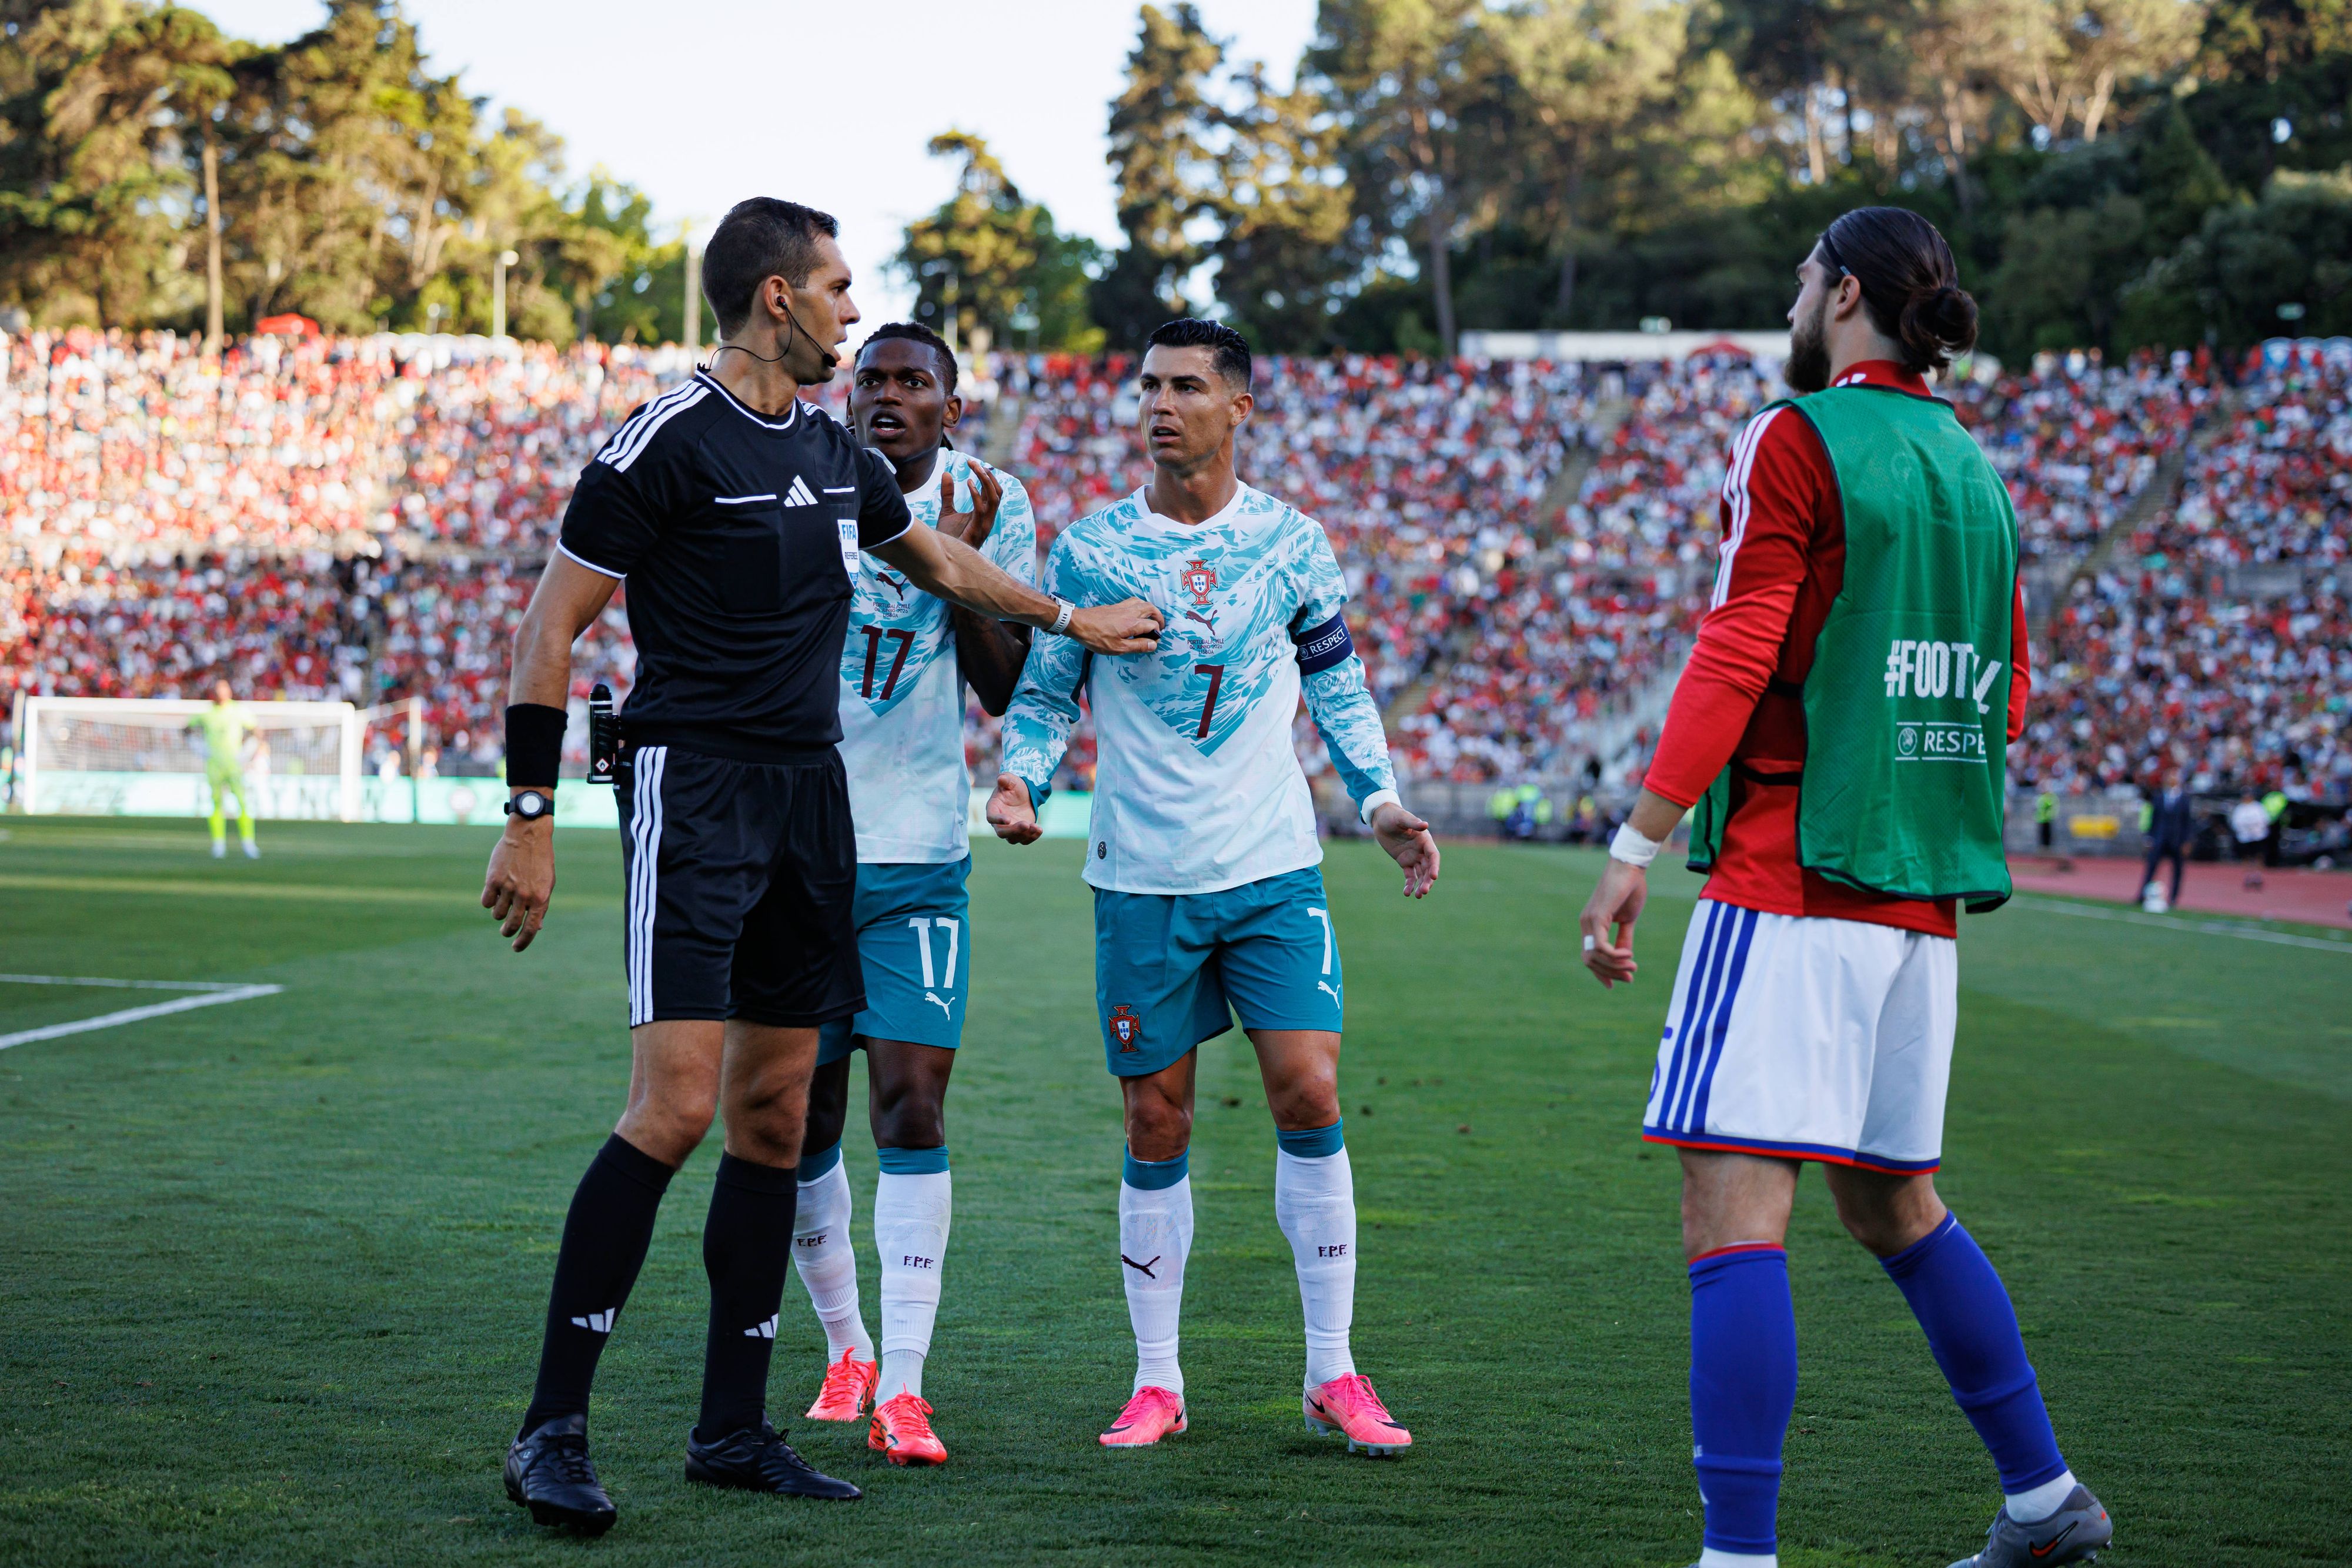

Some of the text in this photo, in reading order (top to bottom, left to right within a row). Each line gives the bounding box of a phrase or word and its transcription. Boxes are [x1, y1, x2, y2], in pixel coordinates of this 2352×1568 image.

[841, 524, 857, 540] FIFA
[844, 551, 858, 560] REFEREE
[1309, 628, 1345, 654] RESPECT
[860, 624, 917, 700] 17
[1194, 663, 1225, 738] 7
[908, 917, 959, 988] 17
[1307, 907, 1332, 975] 7
[904, 1255, 934, 1269] F.P.F.
[1318, 1243, 1347, 1257] F.P.F.
